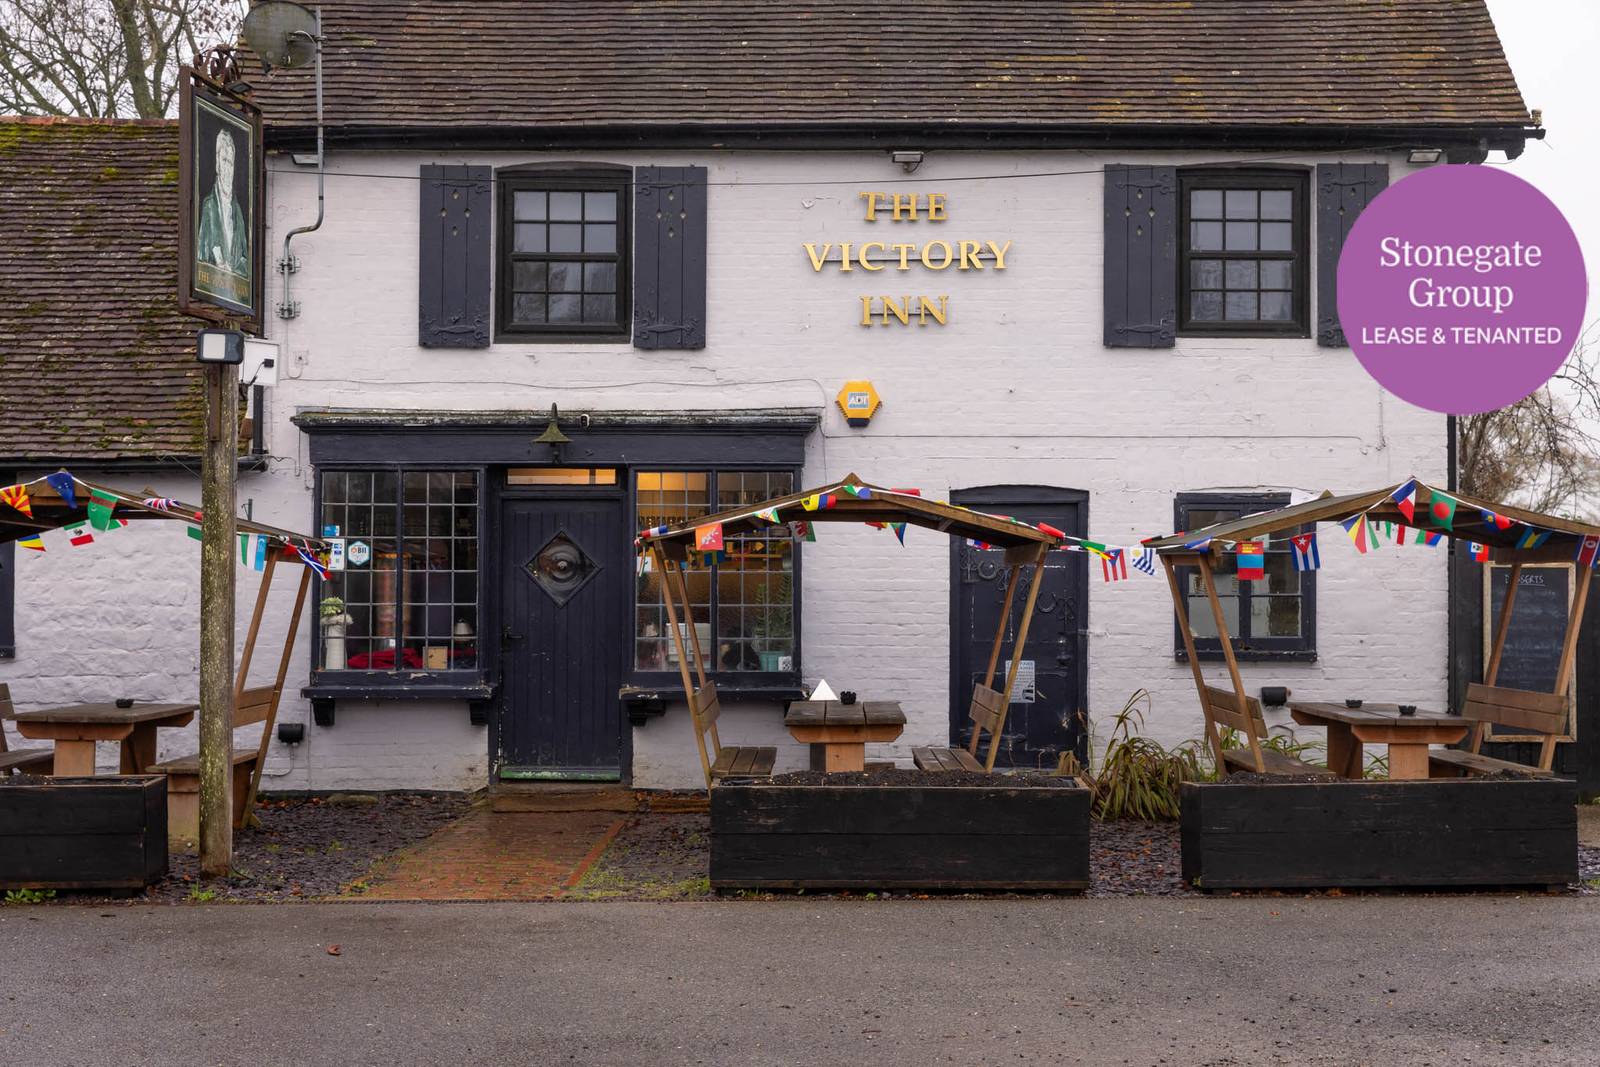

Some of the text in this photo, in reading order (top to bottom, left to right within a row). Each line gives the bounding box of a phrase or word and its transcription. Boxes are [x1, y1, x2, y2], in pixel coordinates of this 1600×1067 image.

[859, 191, 950, 222] THE
[803, 240, 1012, 272] VICTORY
[859, 295, 950, 327] INN
